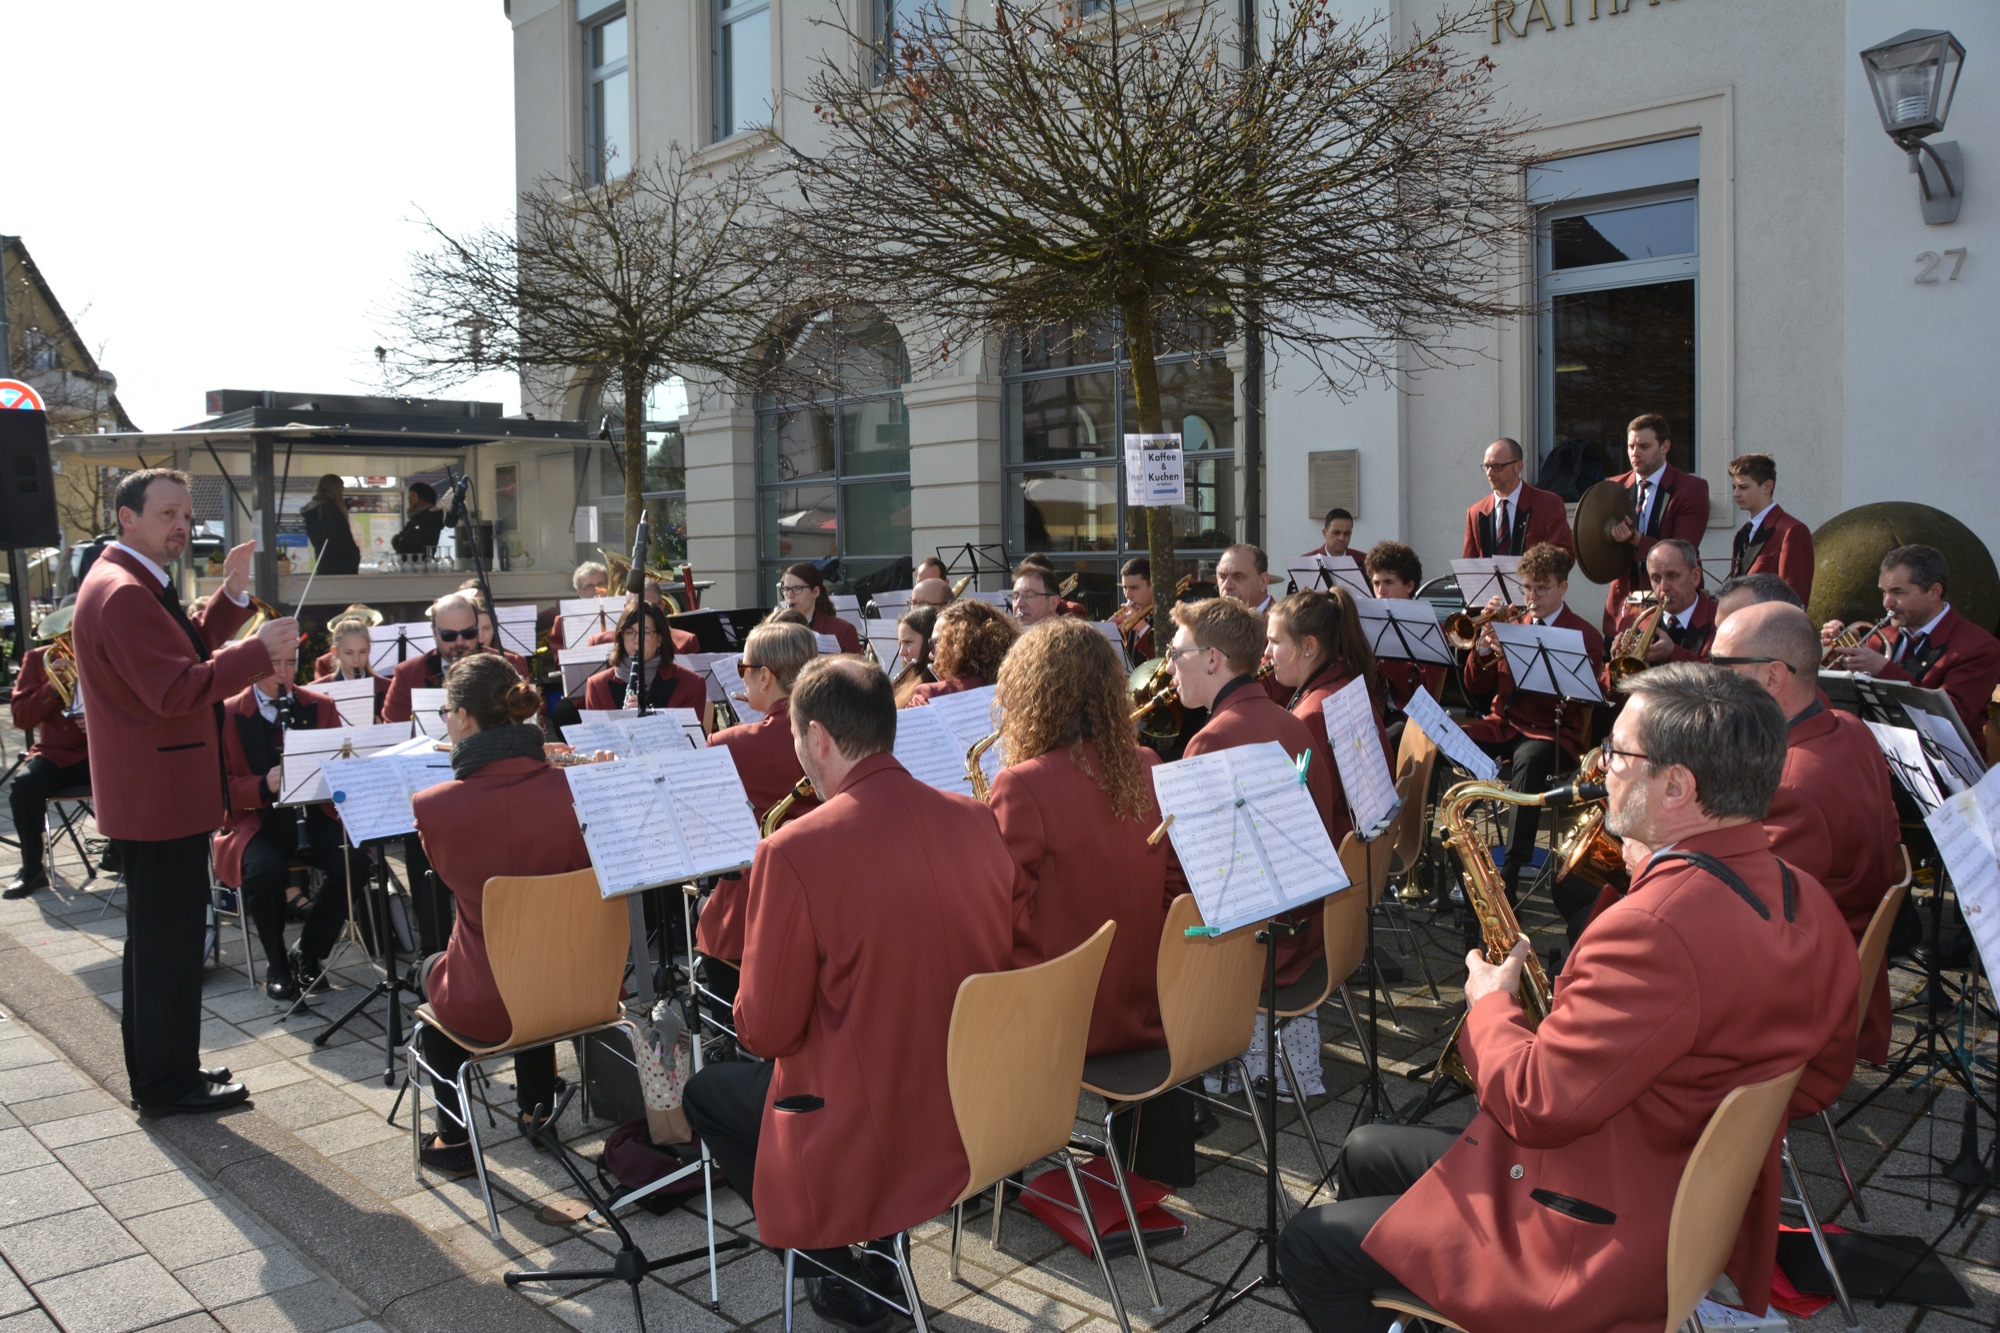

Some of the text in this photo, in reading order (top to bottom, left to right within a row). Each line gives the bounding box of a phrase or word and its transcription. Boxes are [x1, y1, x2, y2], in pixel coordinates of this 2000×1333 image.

[1914, 246, 1967, 284] 27
[1148, 452, 1177, 461] Kaffee
[1161, 462, 1167, 470] &
[1148, 472, 1179, 481] Kuchen
